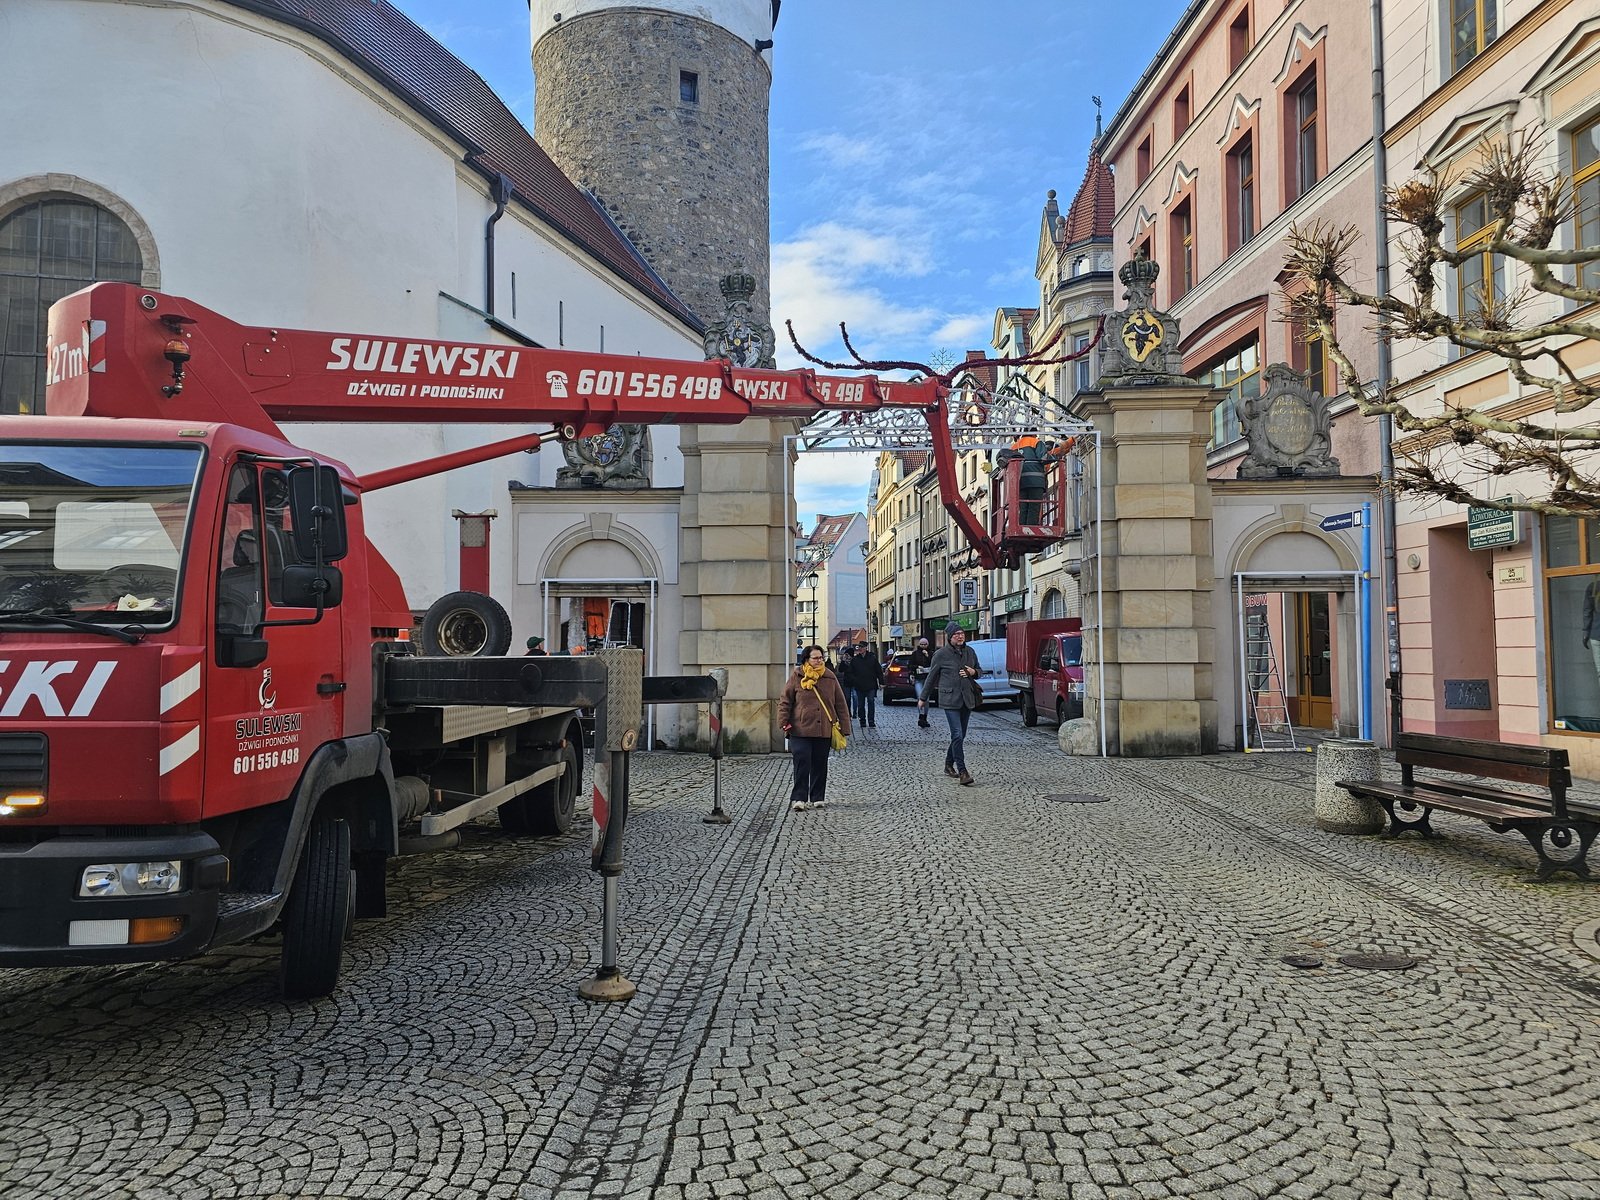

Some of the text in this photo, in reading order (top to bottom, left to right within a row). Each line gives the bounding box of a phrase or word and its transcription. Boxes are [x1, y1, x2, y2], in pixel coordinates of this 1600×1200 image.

[52, 342, 82, 384] 27m
[326, 338, 519, 378] SULEWSKI
[410, 384, 416, 397] I
[420, 384, 504, 400] PODNOŚNIKI
[577, 369, 722, 400] 601 556 498
[835, 383, 865, 402] 498
[1480, 520, 1501, 528] adwokat
[236, 713, 301, 739] SULEWSKI
[238, 739, 262, 752] DŹWIGI
[265, 734, 298, 747] PODNOŚNIKI
[233, 747, 299, 775] 601 556 498
